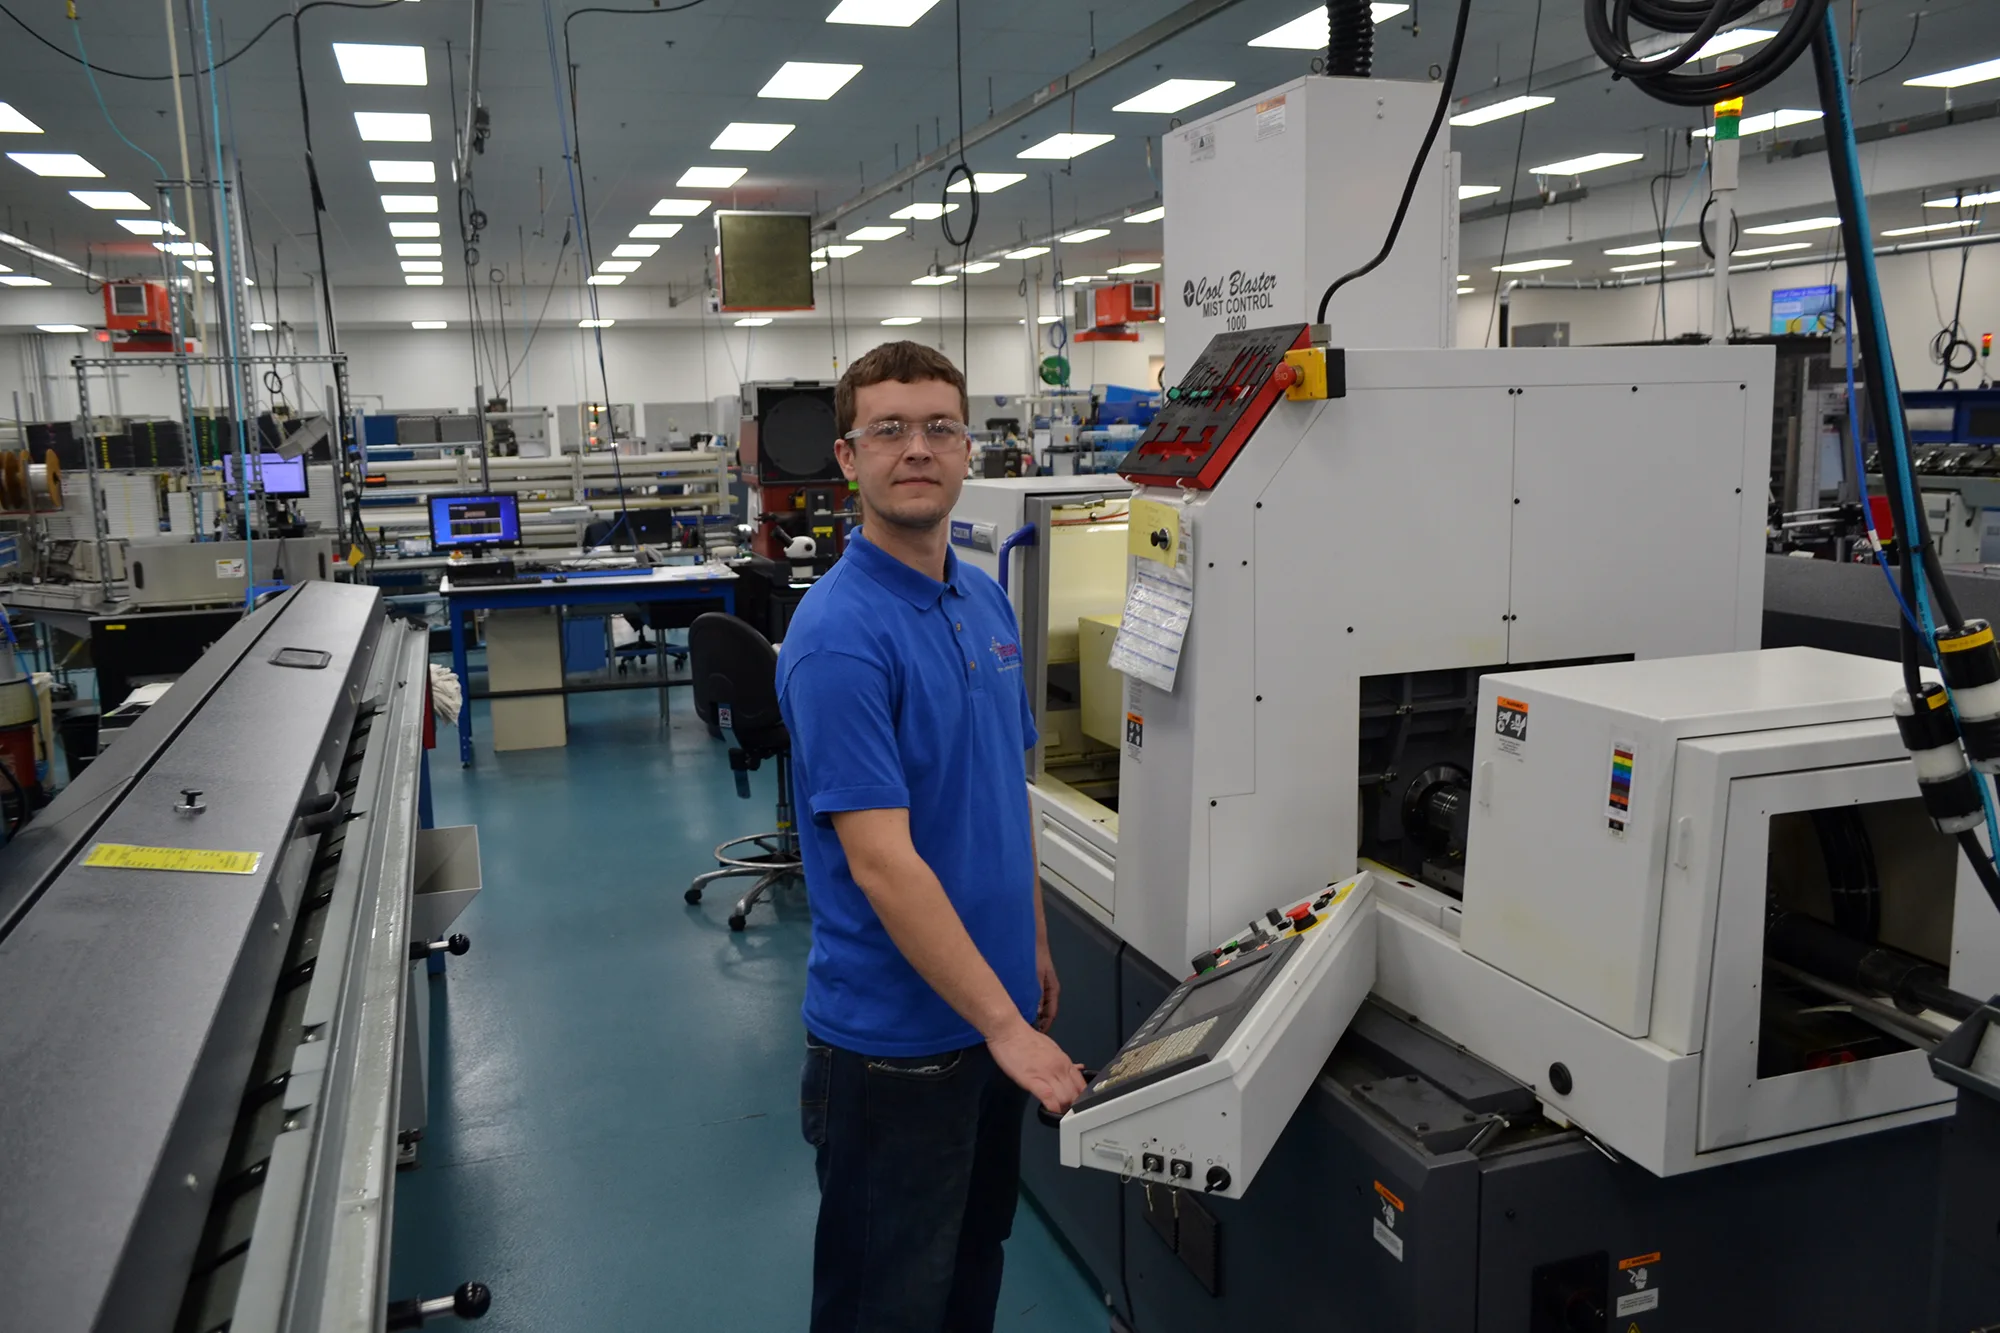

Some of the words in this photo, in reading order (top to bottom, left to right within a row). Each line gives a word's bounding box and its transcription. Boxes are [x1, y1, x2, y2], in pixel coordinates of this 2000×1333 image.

[1196, 276, 1224, 306] Cool
[1229, 269, 1277, 296] Blaster
[1203, 300, 1223, 318] MIST
[1226, 292, 1273, 314] CONTROL
[1226, 314, 1247, 331] 1000
